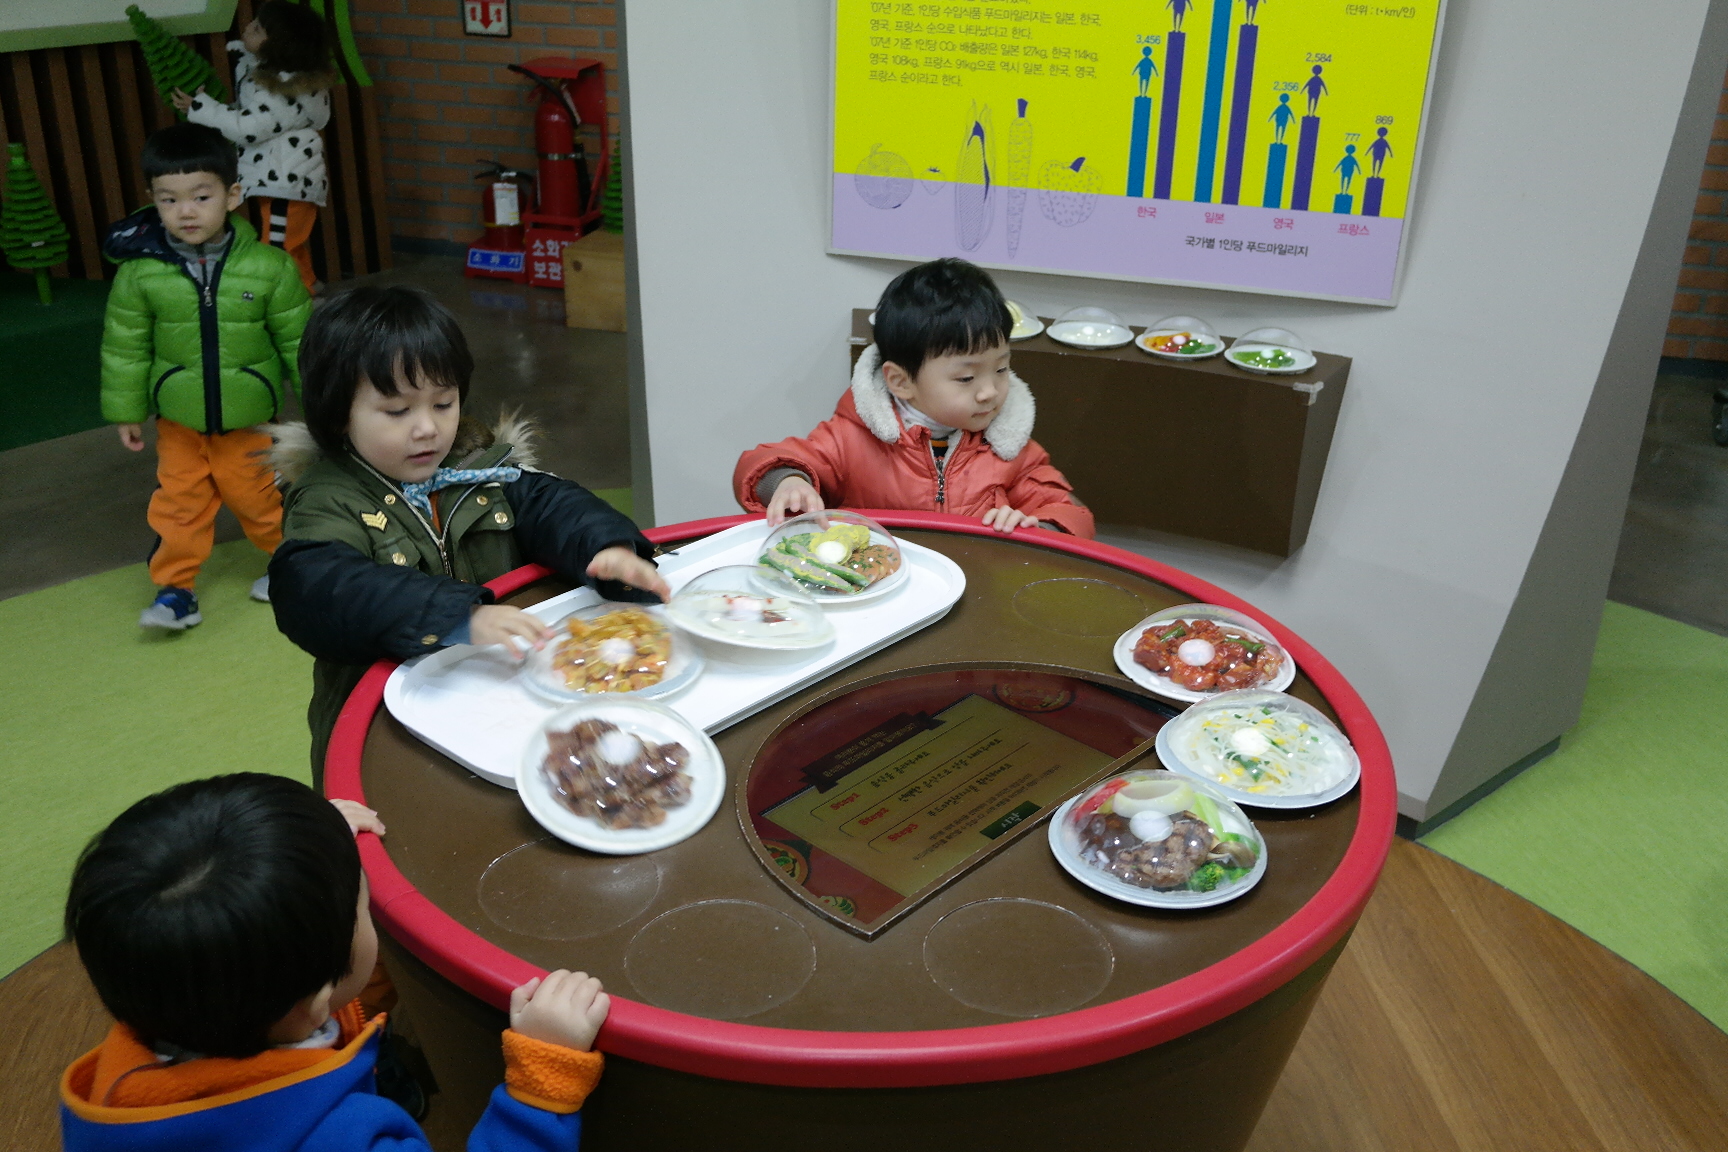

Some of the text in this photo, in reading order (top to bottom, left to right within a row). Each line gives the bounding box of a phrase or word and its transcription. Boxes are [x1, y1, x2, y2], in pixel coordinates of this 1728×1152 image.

[944, 6, 981, 20] 수입식품
[985, 8, 1052, 24] 푸드마일리지는
[895, 20, 923, 33] 프랑스
[926, 22, 956, 34] 순으로
[1136, 34, 1161, 45] 3,456
[924, 56, 953, 69] 프랑스
[1000, 61, 1019, 73] 역시
[1305, 52, 1332, 63] 2,584
[868, 70, 962, 86] 프랑스 순이라고 한다.
[1273, 81, 1299, 92] 2,356
[1375, 116, 1394, 126] 869
[1344, 132, 1360, 142] 777
[1137, 206, 1157, 218] 한국
[1204, 211, 1225, 225] 일본
[1273, 217, 1294, 230] 영국
[1337, 223, 1370, 236] 프랑스
[532, 239, 572, 258] 소화
[1185, 236, 1309, 257] 국가별 1인당 푸드마일리지
[830, 793, 861, 810] Step1
[858, 808, 889, 826] Step2
[887, 823, 919, 842] Step3
